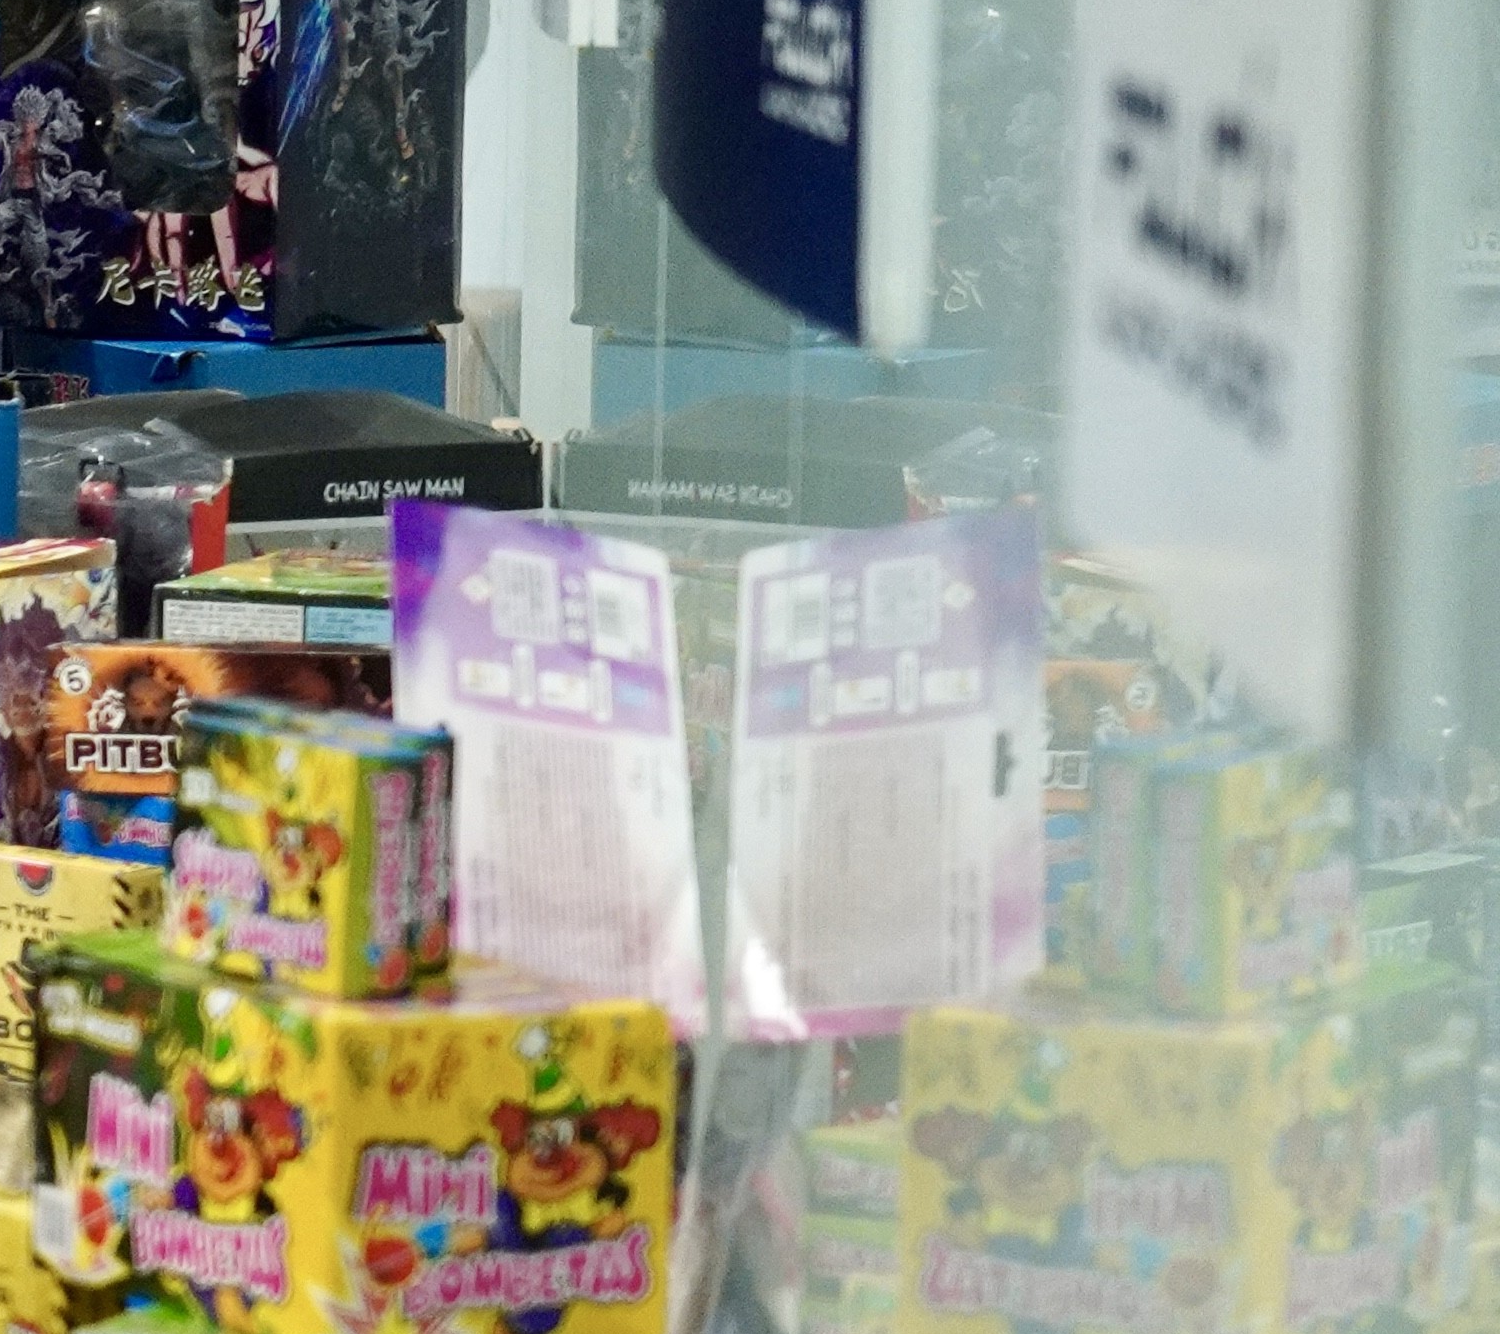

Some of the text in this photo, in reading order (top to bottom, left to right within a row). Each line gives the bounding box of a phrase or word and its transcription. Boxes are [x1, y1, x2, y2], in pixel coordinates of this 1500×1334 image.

[323, 475, 465, 503] CHAIN SAW MAN
[67, 669, 84, 693] 5
